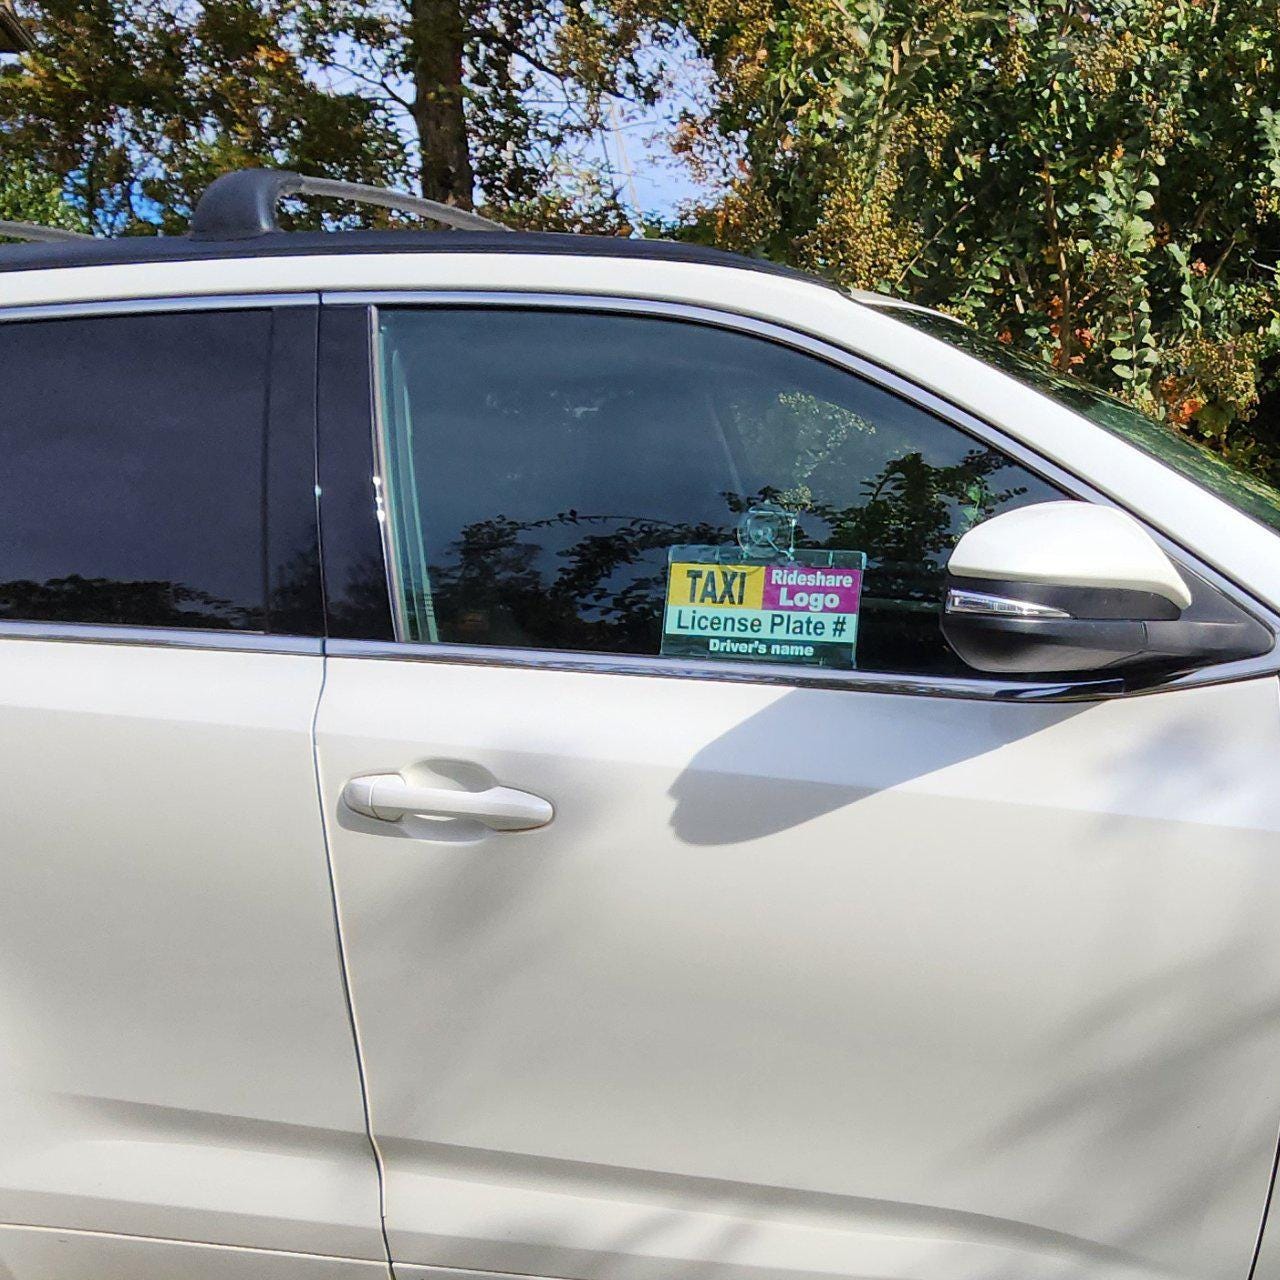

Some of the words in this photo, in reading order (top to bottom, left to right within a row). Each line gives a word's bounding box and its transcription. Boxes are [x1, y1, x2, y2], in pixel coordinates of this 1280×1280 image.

[686, 569, 748, 606] TAXI
[771, 569, 853, 588] Rideshare
[779, 589, 840, 612] Logo
[676, 609, 762, 633] License
[769, 613, 826, 637] Plate
[832, 616, 847, 638] #
[709, 638, 767, 655] Driver's
[771, 644, 815, 657] name
